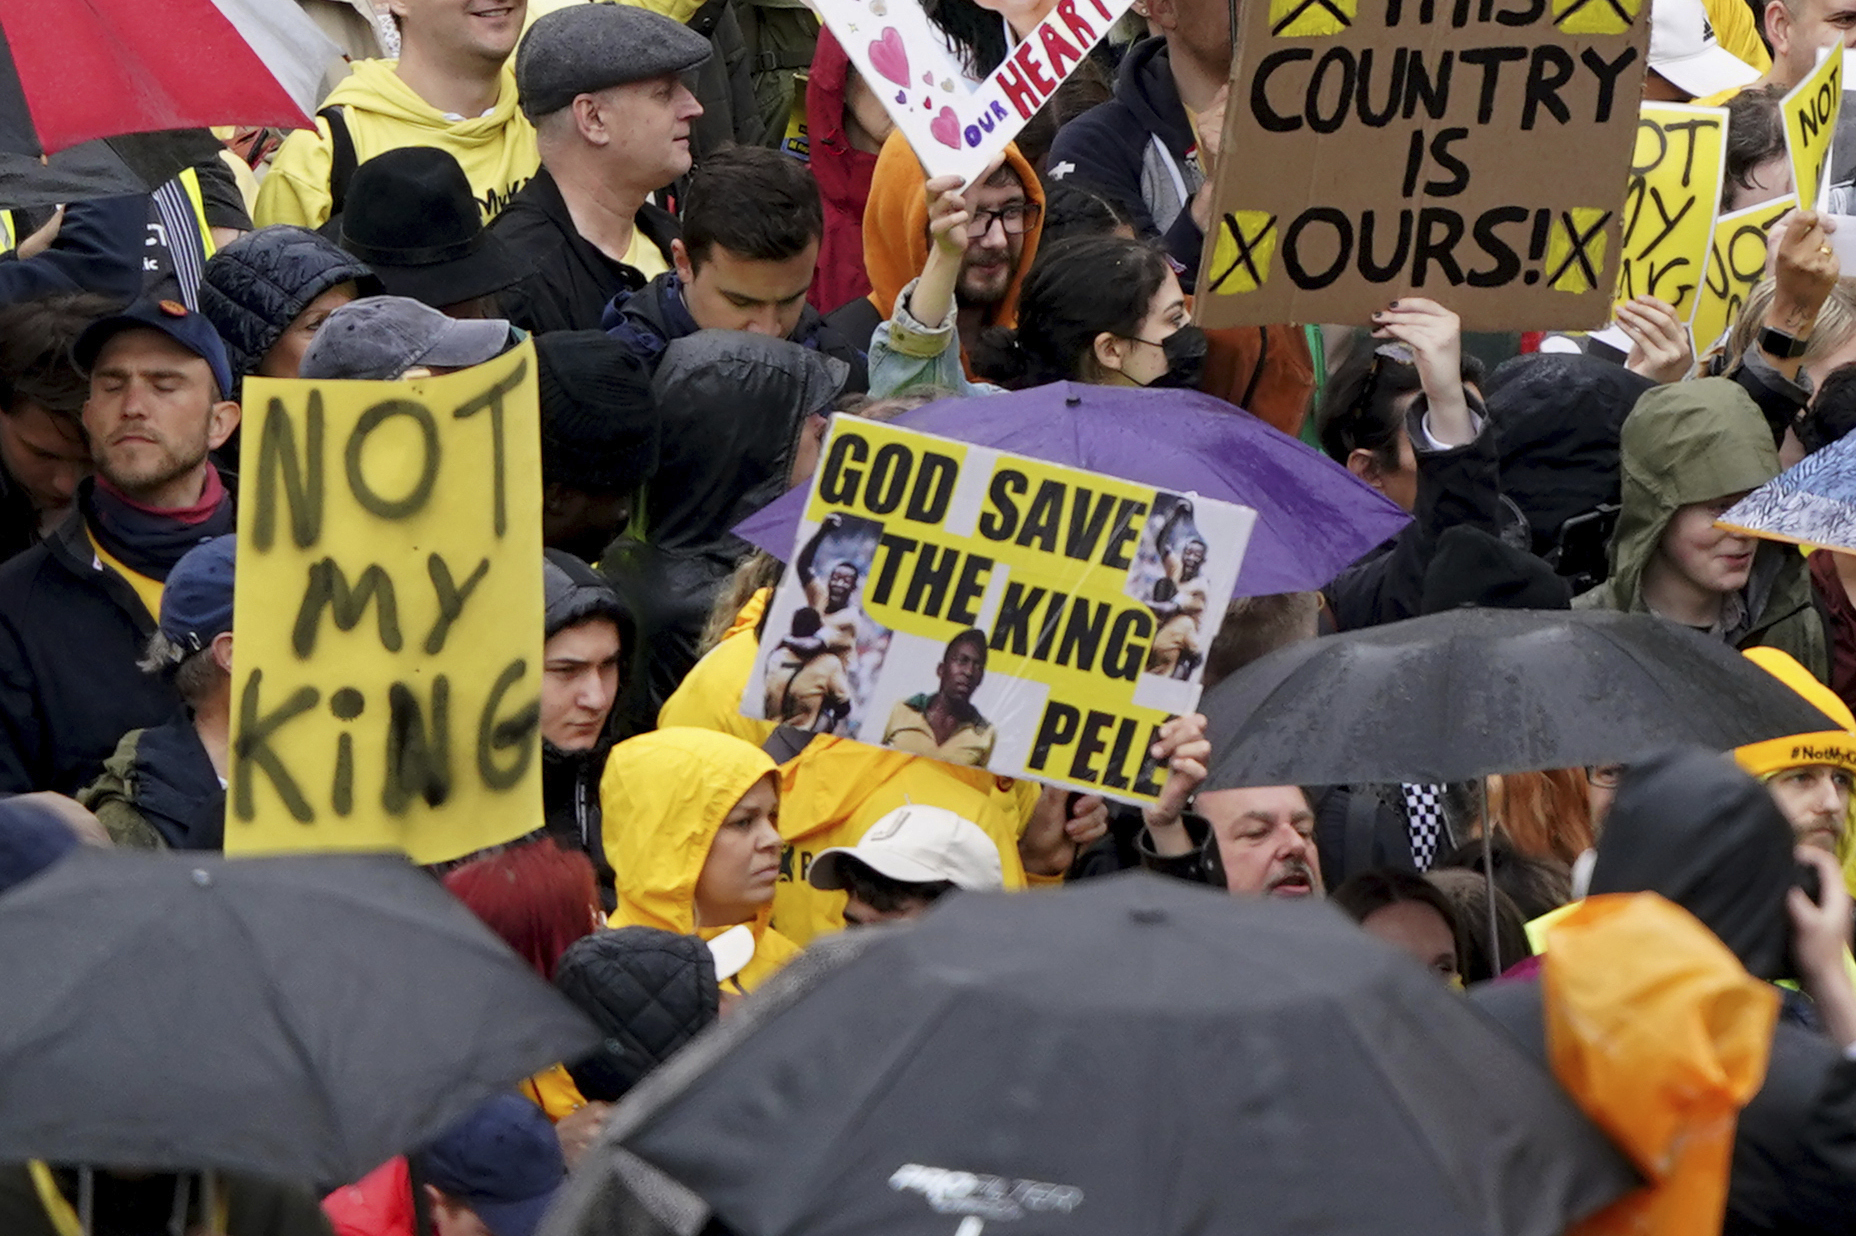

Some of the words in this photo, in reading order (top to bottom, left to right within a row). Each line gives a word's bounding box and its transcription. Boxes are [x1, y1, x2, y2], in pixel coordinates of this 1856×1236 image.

[1250, 44, 1638, 133] COUNTRY
[1799, 66, 1838, 147] NOT
[1401, 127, 1470, 198] IS
[1281, 206, 1549, 290] OURS!
[251, 358, 530, 555] NOT
[818, 433, 962, 524] GOD
[979, 469, 1147, 570] SAVE
[292, 552, 489, 662] MY
[870, 533, 992, 626] THE
[993, 585, 1156, 683] KING
